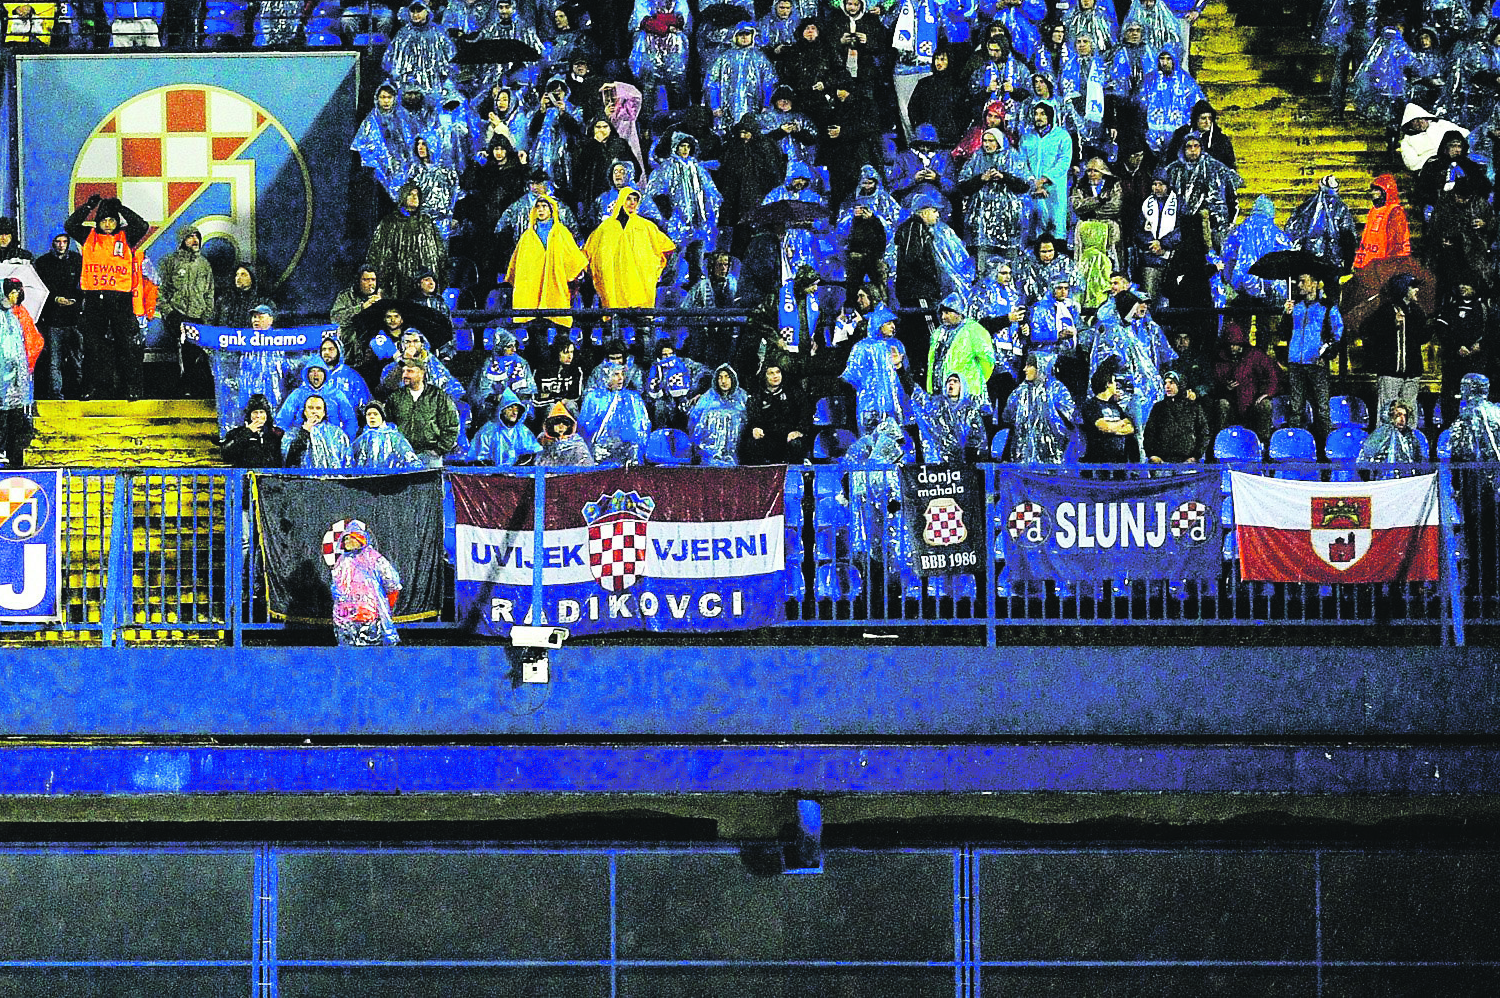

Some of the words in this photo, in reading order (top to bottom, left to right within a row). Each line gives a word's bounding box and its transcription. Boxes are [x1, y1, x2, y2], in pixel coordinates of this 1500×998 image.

[85, 263, 128, 275] STEWARD
[92, 274, 117, 287] 356
[219, 330, 247, 348] gnk
[249, 330, 307, 347] dinamo
[917, 465, 961, 484] donja
[916, 482, 964, 499] mahala
[1055, 501, 1167, 549] SLUNJ
[651, 533, 768, 563] VJERNI
[920, 553, 947, 570] BBB
[948, 550, 977, 568] 1986
